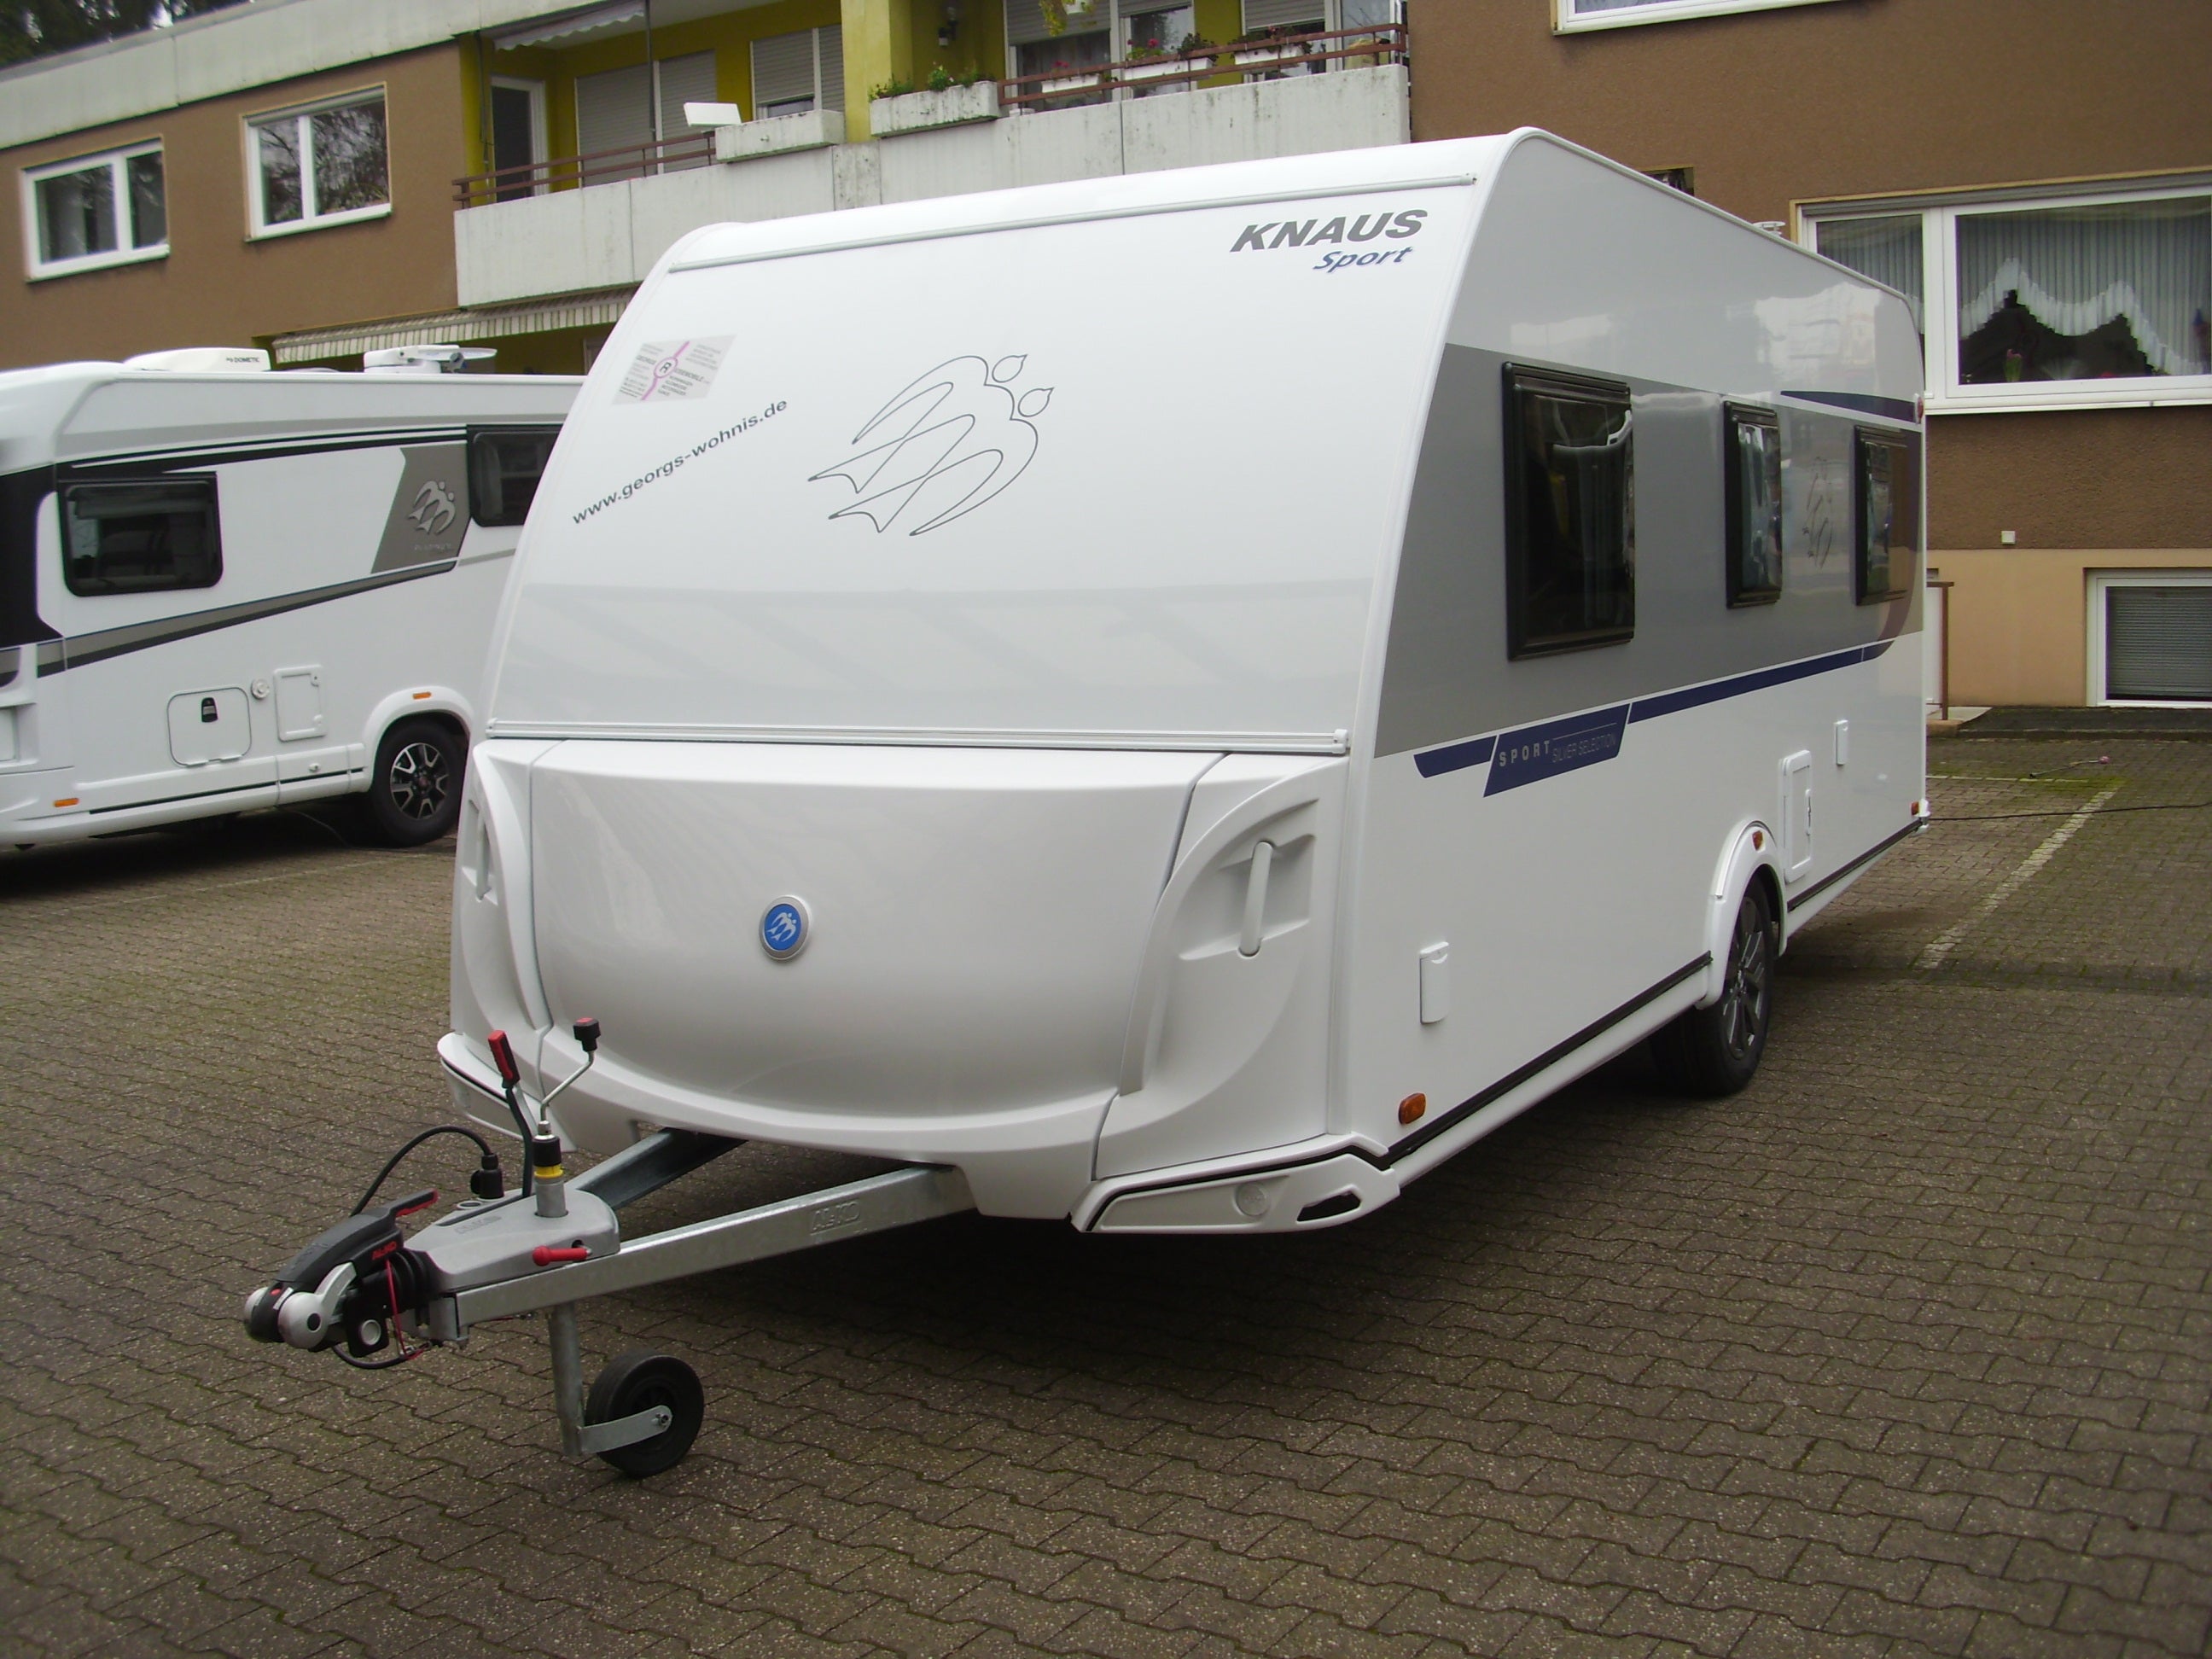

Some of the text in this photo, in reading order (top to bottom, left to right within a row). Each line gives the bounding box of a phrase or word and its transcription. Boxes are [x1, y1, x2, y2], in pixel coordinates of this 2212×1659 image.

[1230, 209, 1428, 253] KNAUS
[1313, 247, 1412, 273] Sport
[573, 400, 787, 523] www.georgs-wohnis.de
[1499, 740, 1550, 766] SPORT
